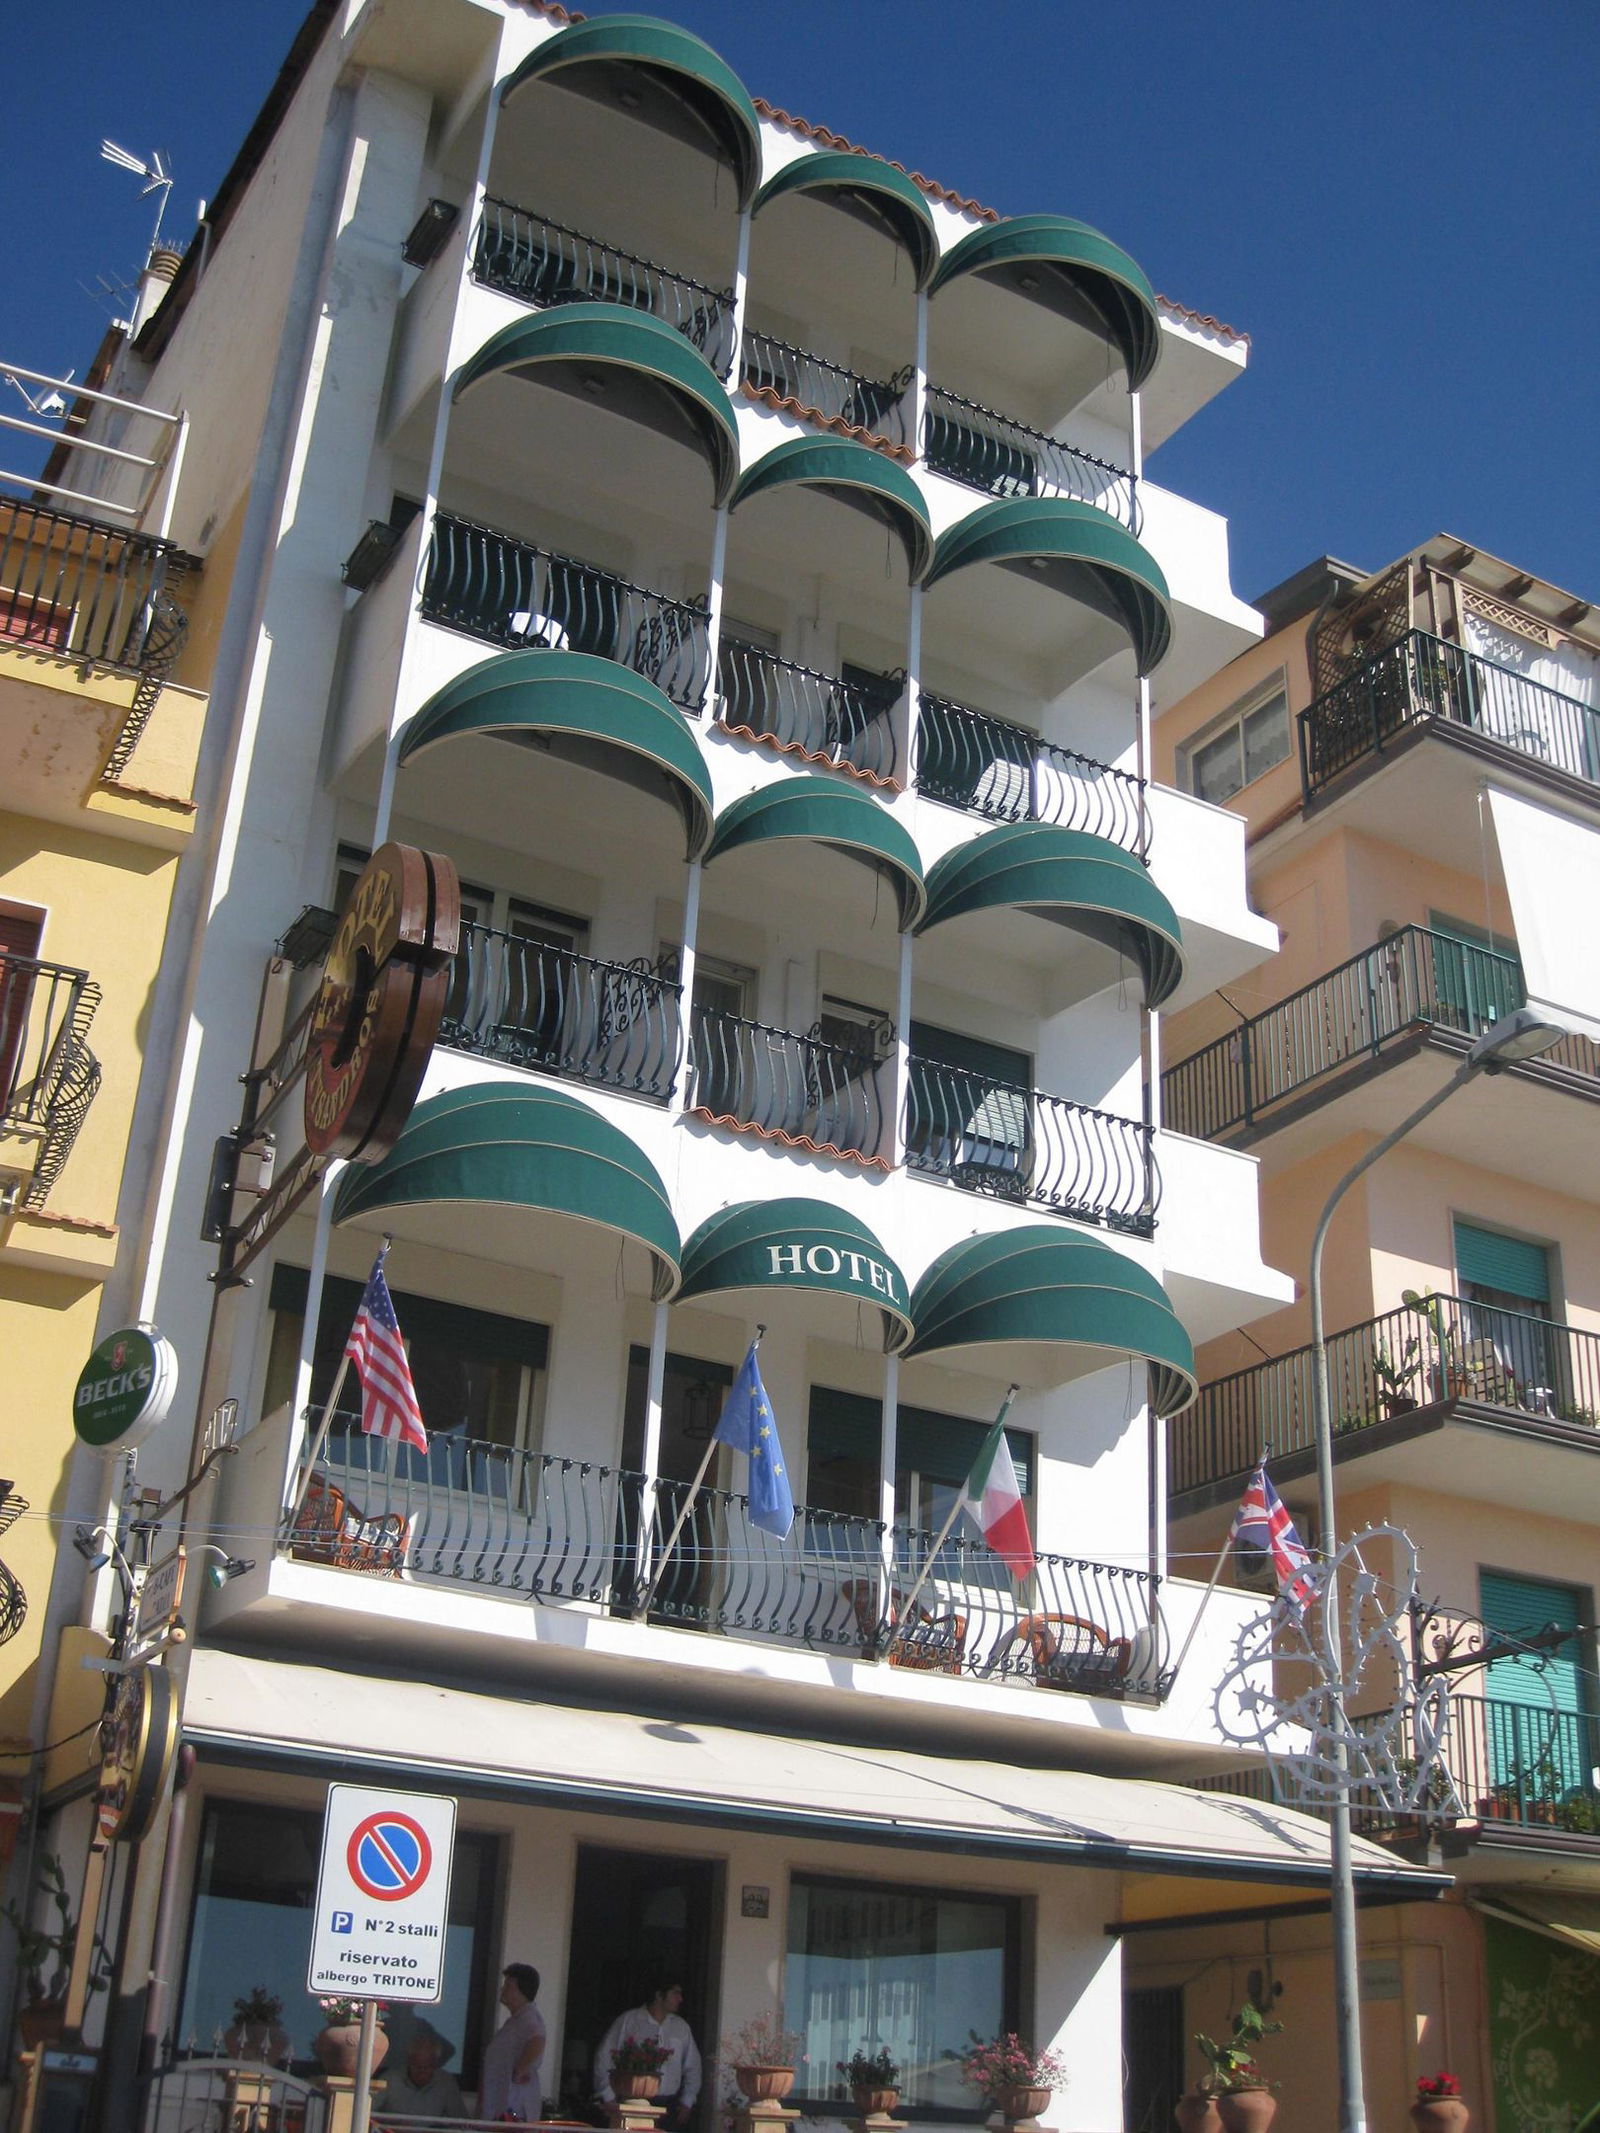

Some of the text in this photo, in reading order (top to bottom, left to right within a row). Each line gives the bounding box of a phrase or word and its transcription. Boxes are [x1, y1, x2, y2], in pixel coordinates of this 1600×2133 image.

[766, 1244, 901, 1305] HOTEL
[77, 1363, 152, 1407] BECK'S
[398, 1923, 438, 1937] stalli
[339, 1950, 418, 1969] riservato
[317, 1970, 436, 1989] albergo TRITONE
